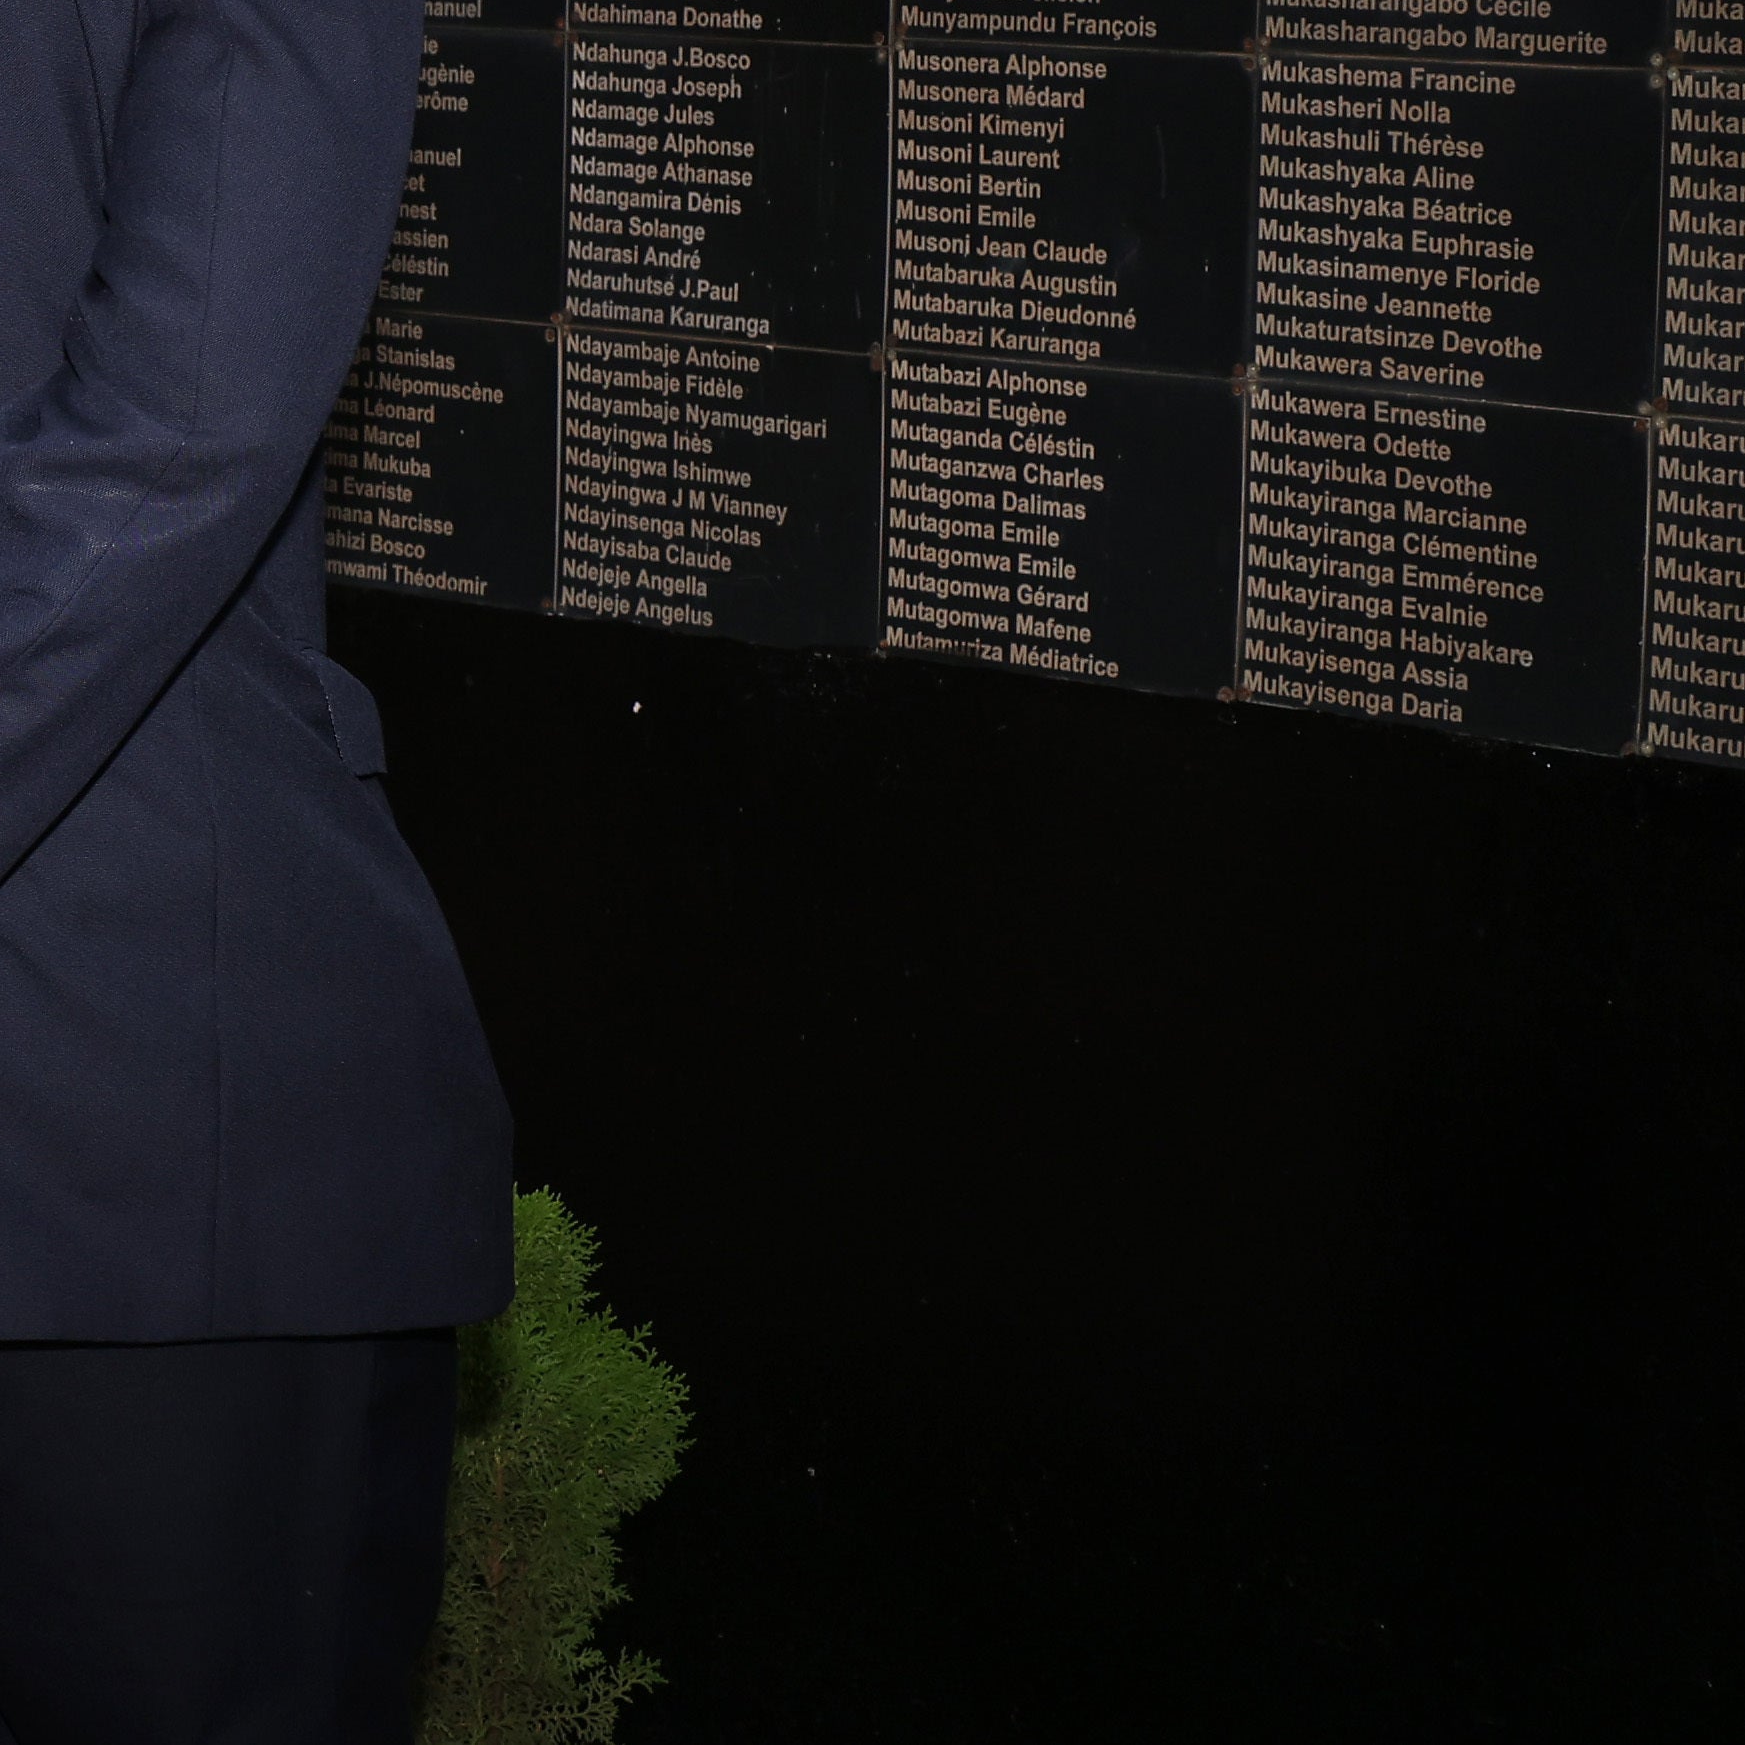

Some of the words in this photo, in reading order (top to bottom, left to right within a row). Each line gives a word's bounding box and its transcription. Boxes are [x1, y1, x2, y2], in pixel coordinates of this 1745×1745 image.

[901, 5, 1056, 36] Munyampundu
[1063, 12, 1157, 41] François
[897, 108, 973, 134] Musoni
[979, 113, 1065, 144] Kimenyi
[1259, 186, 1405, 221] Mukashyaka
[1412, 197, 1512, 227] Béatrice
[569, 210, 623, 235] Ndara
[628, 215, 706, 246] Solange
[894, 258, 1015, 289] Mutabaruka
[1020, 268, 1117, 298] Augustin
[1255, 312, 1435, 351] Mukaturatsinze
[1442, 329, 1543, 361] Devothe
[376, 344, 456, 371] Stanislas
[566, 389, 680, 425] Ndayambaje
[685, 402, 827, 441] Nyamugarigari
[378, 507, 454, 536] Narcisse
[562, 557, 631, 589] Ndejeje
[635, 568, 708, 598] Angella
[1248, 543, 1394, 587] Mukayiranga
[1402, 563, 1544, 603] Emmérence
